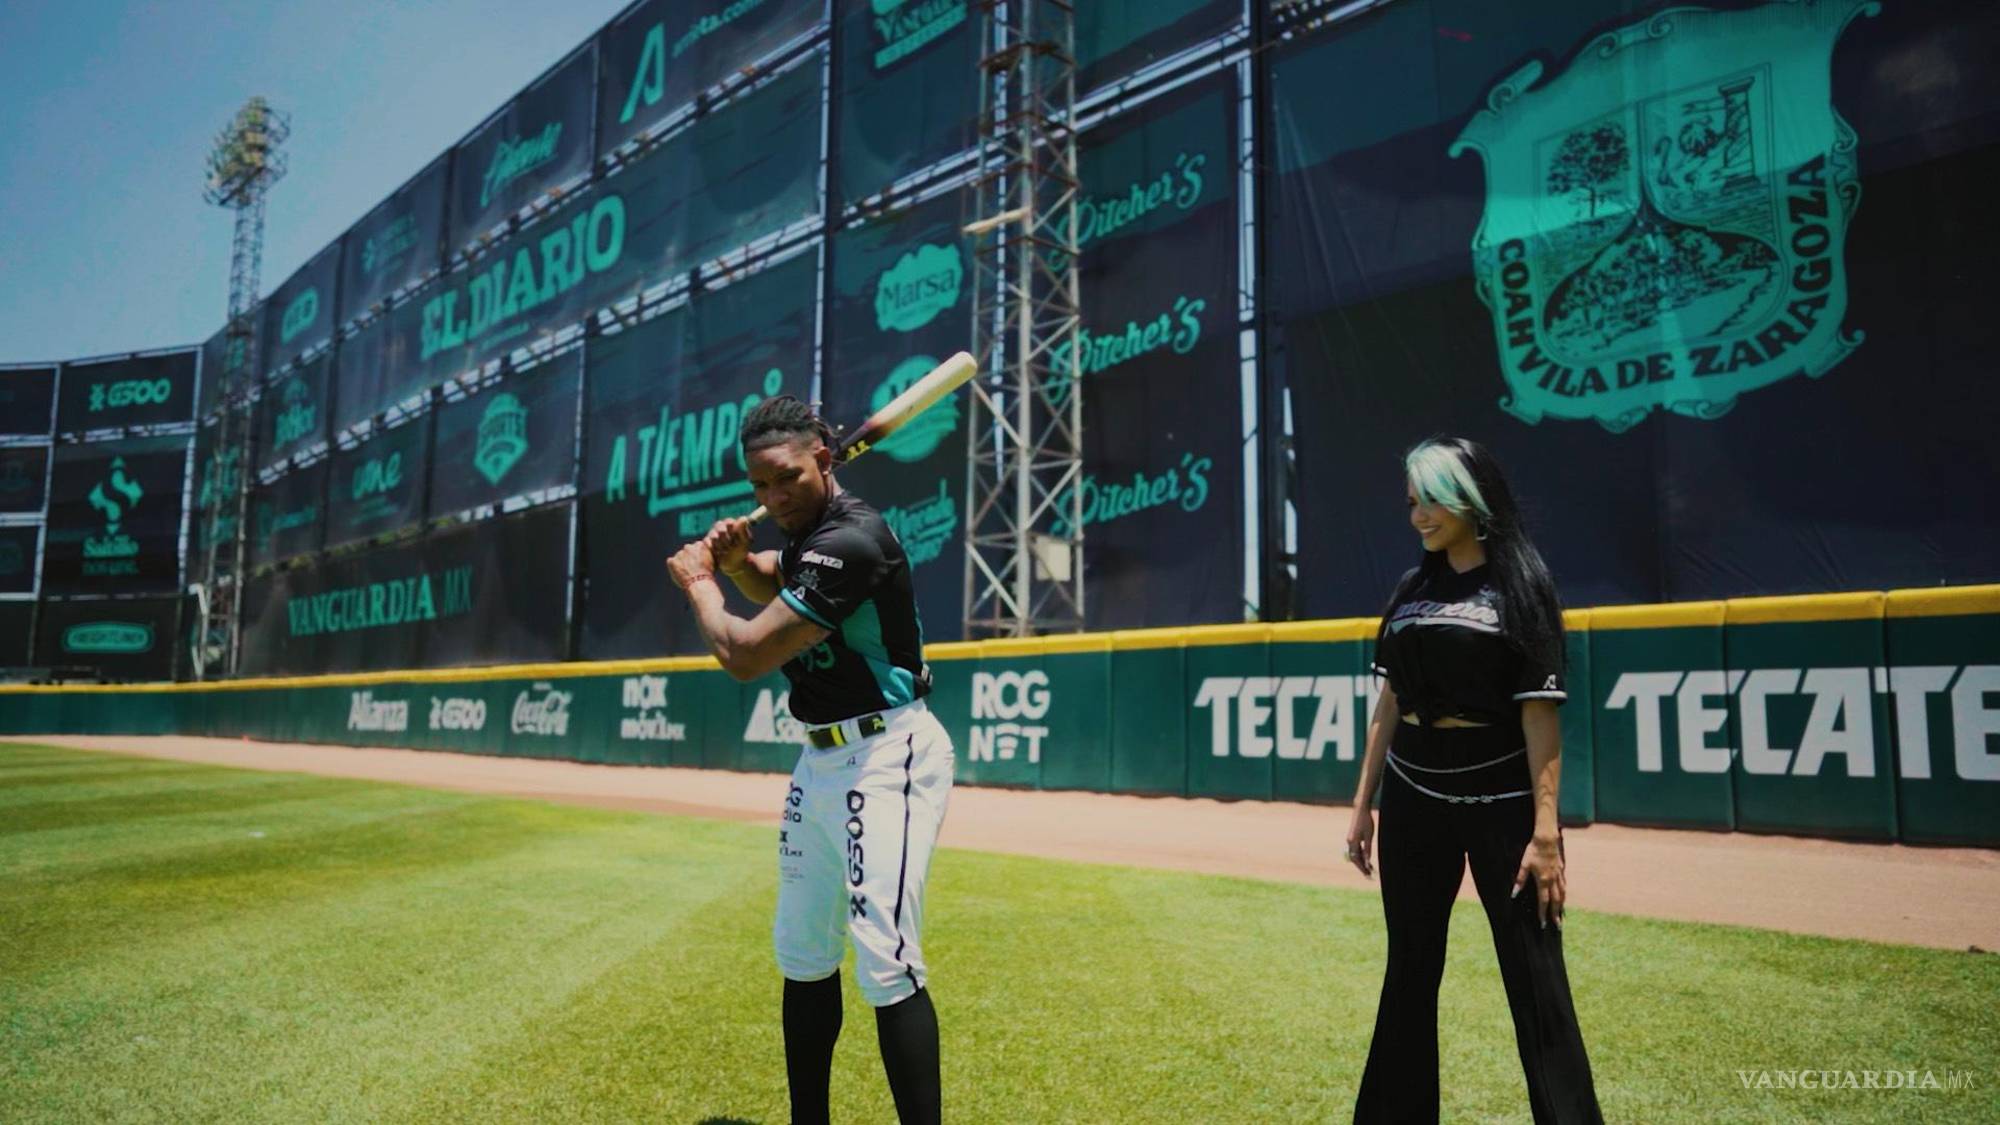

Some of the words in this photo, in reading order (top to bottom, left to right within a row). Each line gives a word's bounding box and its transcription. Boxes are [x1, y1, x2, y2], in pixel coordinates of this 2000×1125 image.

[467, 194, 627, 342] DIARIO
[1616, 352, 1675, 390] DE
[1688, 154, 1833, 379] ZARAGOZA
[606, 433, 628, 504] A
[287, 573, 438, 638] VANGUARDIA
[1193, 674, 1389, 762] TECAT
[1605, 664, 2000, 781] TECATE
